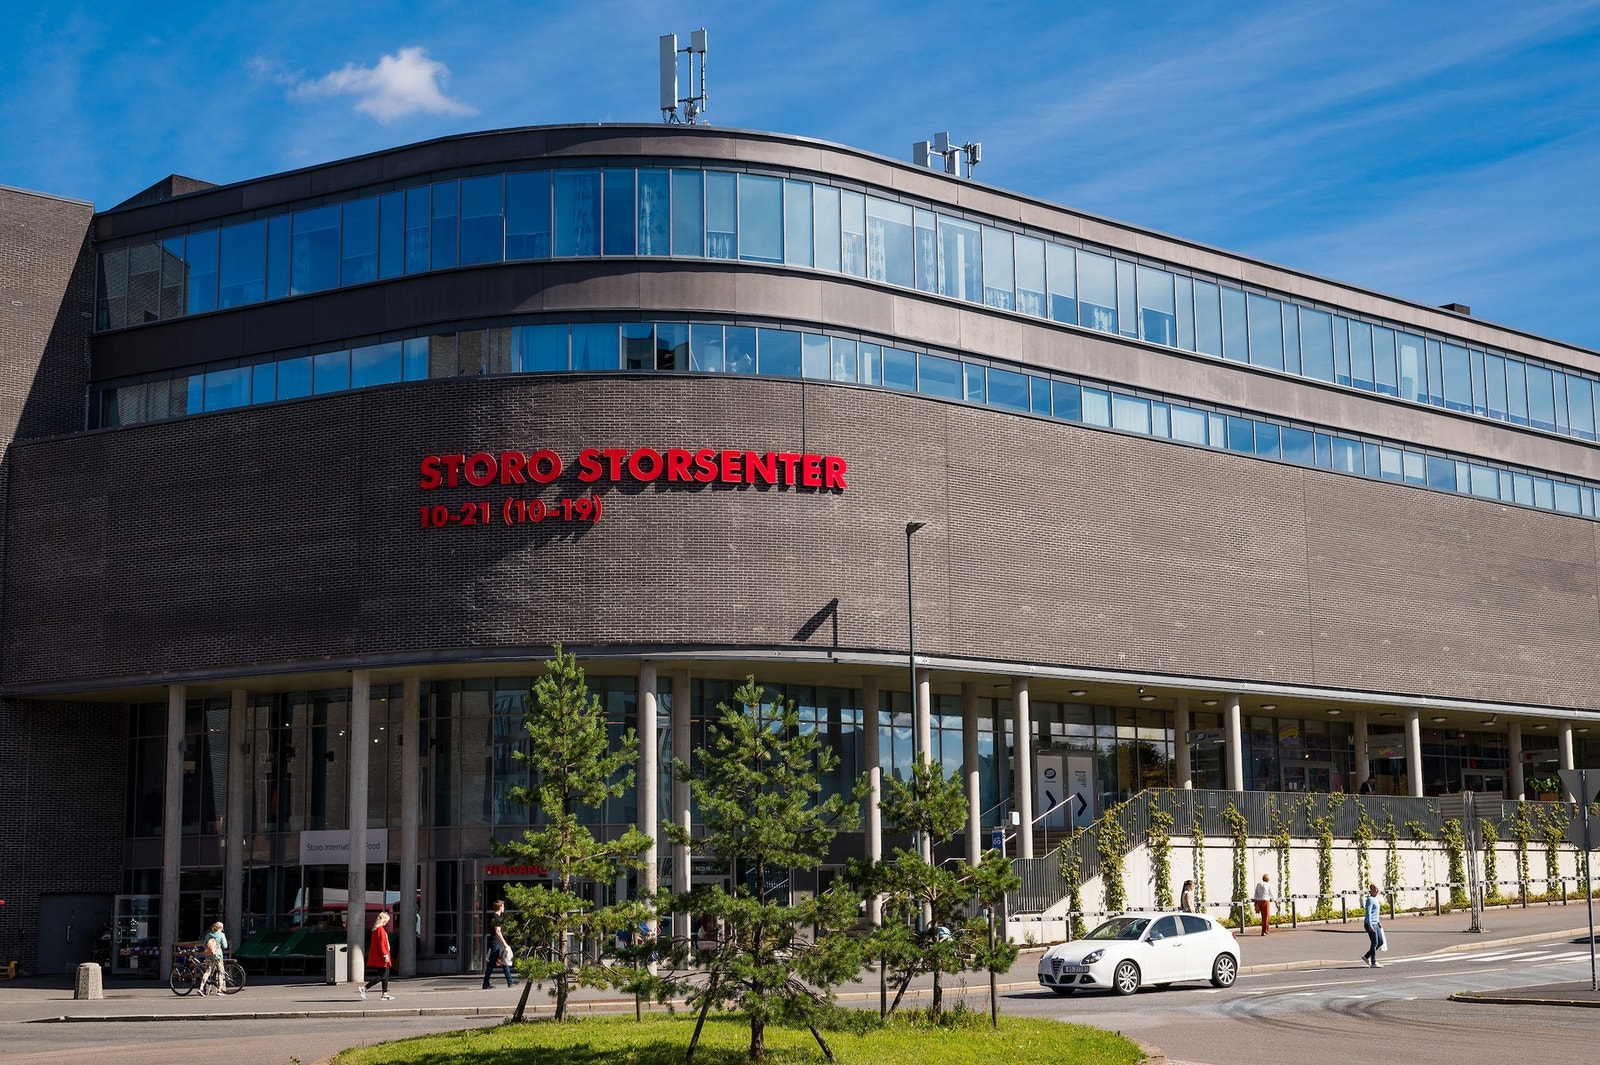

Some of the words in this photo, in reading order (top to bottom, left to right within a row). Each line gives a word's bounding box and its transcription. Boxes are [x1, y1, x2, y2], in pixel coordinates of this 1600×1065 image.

[419, 449, 562, 490] STORO
[578, 448, 848, 489] STORSENTER
[419, 502, 490, 529] 10-21
[503, 494, 602, 526] (10-19)
[307, 843, 323, 851] Storo
